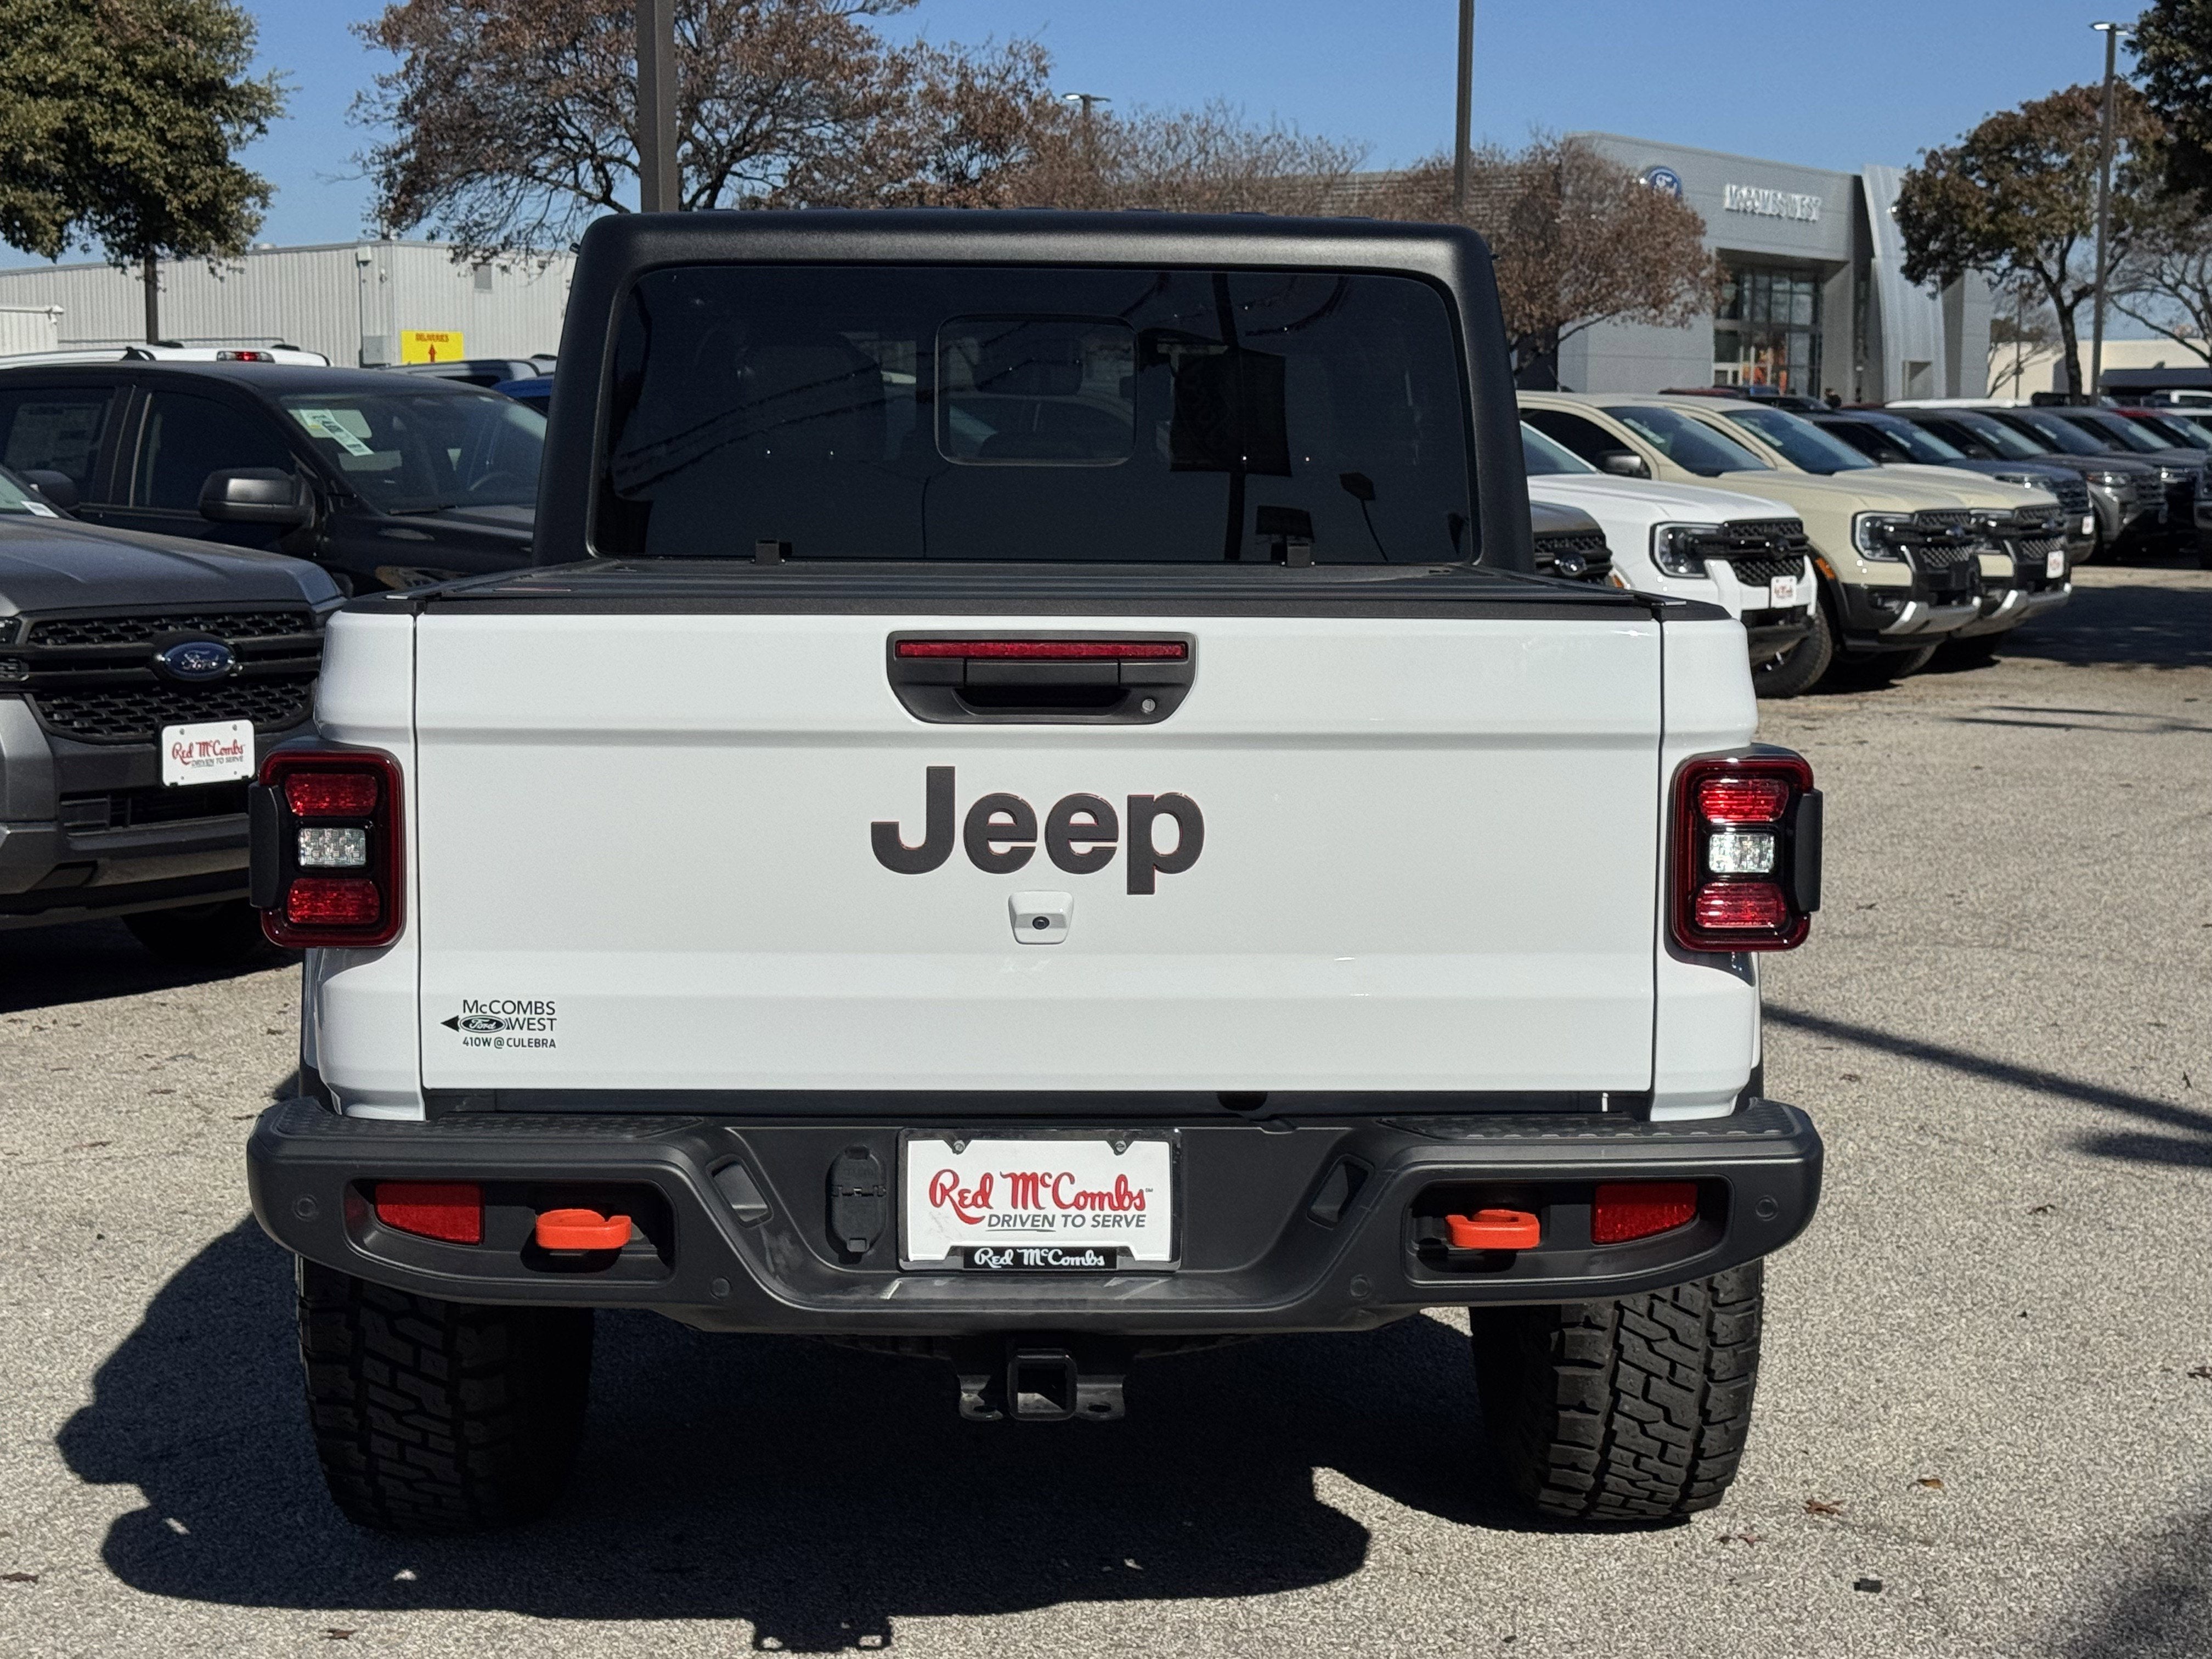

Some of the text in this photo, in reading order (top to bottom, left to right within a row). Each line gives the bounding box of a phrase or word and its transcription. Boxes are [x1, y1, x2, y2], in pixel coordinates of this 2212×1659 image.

[172, 739, 244, 765] Red McCombs
[871, 766, 1205, 895] Jeep
[462, 999, 556, 1015] McCOMBS
[508, 1017, 557, 1031] WEST
[462, 1037, 492, 1047] 410W
[506, 1037, 556, 1048] CULEBRA
[929, 1169, 1147, 1225] Red McCombs
[987, 1214, 1147, 1228] DRIVEN TO SERVE
[974, 1247, 1105, 1268] Red McCombs
